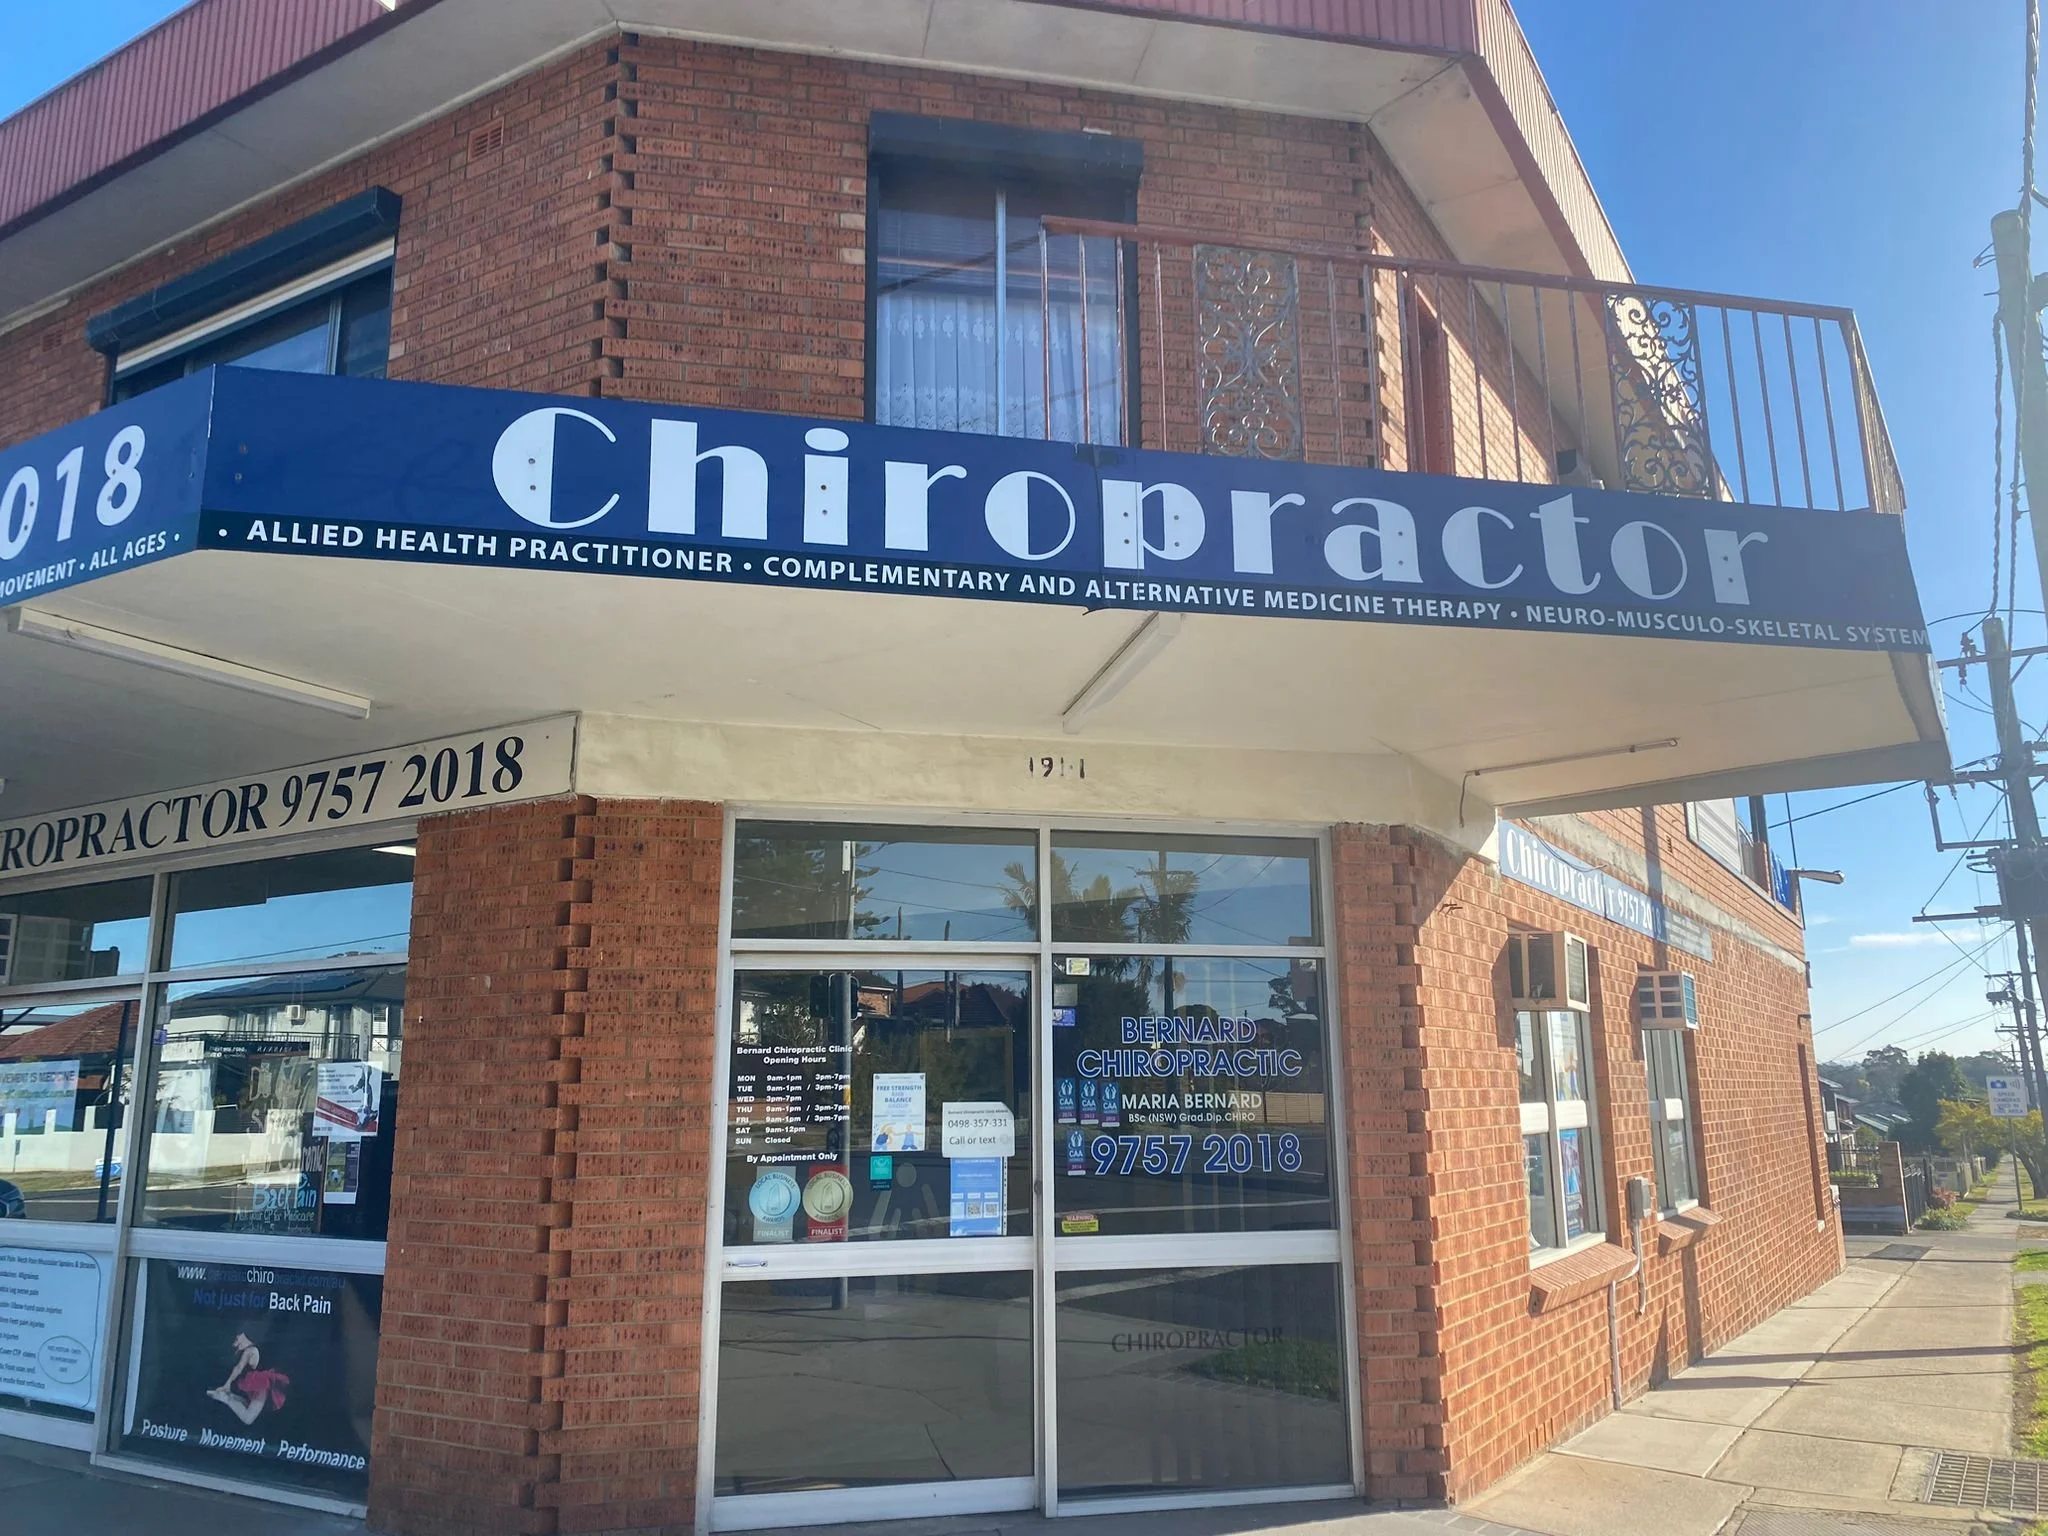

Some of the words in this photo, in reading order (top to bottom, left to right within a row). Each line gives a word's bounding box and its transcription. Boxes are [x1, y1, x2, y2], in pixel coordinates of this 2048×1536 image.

[492, 407, 1768, 605] Chiropractor
[89, 546, 118, 571] ALL
[123, 531, 167, 561] AGES
[246, 520, 364, 547] ALLIED
[376, 528, 497, 556] HEALTH
[509, 537, 733, 573] PRACTITIONER
[763, 556, 1010, 592] COMPLEMENTARY
[1019, 574, 1076, 597] AND
[1085, 579, 1255, 607] ALTERNATIVE
[1264, 590, 1385, 615] MEDICINE
[1392, 597, 1501, 620] THERAPY
[1526, 605, 1840, 641] NEURO-MUSCULO-SKELETAL
[0, 783, 268, 871] ROPRACTOR
[279, 761, 387, 828] 9757
[398, 736, 523, 809] 2018
[1618, 888, 1639, 925] 9757
[1121, 1016, 1257, 1044] BERNARD
[737, 1046, 772, 1055] Bernard
[774, 1046, 827, 1056] Chiropractic
[829, 1045, 853, 1053] Clinic
[763, 1057, 799, 1065] Opening
[1077, 1049, 1302, 1078] CHIROPRACTIC
[815, 1073, 850, 1081] 3pm-7pm
[766, 1095, 802, 1103] 3pm-7pm
[1103, 1102, 1117, 1110] CAA
[1121, 1093, 1180, 1110] MARIA
[1185, 1093, 1262, 1109] BERNARD
[814, 1104, 850, 1112] 3pm-7pm
[765, 1116, 801, 1124] 9am-1pm
[1128, 1114, 1146, 1123] BSc
[1148, 1113, 1177, 1124] (NSW)
[765, 1126, 806, 1134] 9am-12pm
[949, 1136, 966, 1145] Call
[979, 1136, 997, 1145] text
[746, 1154, 758, 1164] By
[760, 1153, 817, 1163] Appointment
[818, 1152, 838, 1161] Only
[1091, 1135, 1193, 1175] 9757
[1202, 1133, 1302, 1174] 2018
[811, 1228, 843, 1236] FINALIST
[193, 1288, 215, 1305] Not
[217, 1289, 246, 1310] just
[270, 1292, 300, 1312] Back
[303, 1294, 331, 1315] Pain
[1111, 1326, 1283, 1353] CHIROPRACTOR
[142, 1419, 188, 1442] Posture
[199, 1428, 265, 1454] Movement
[277, 1440, 365, 1470] Performance
